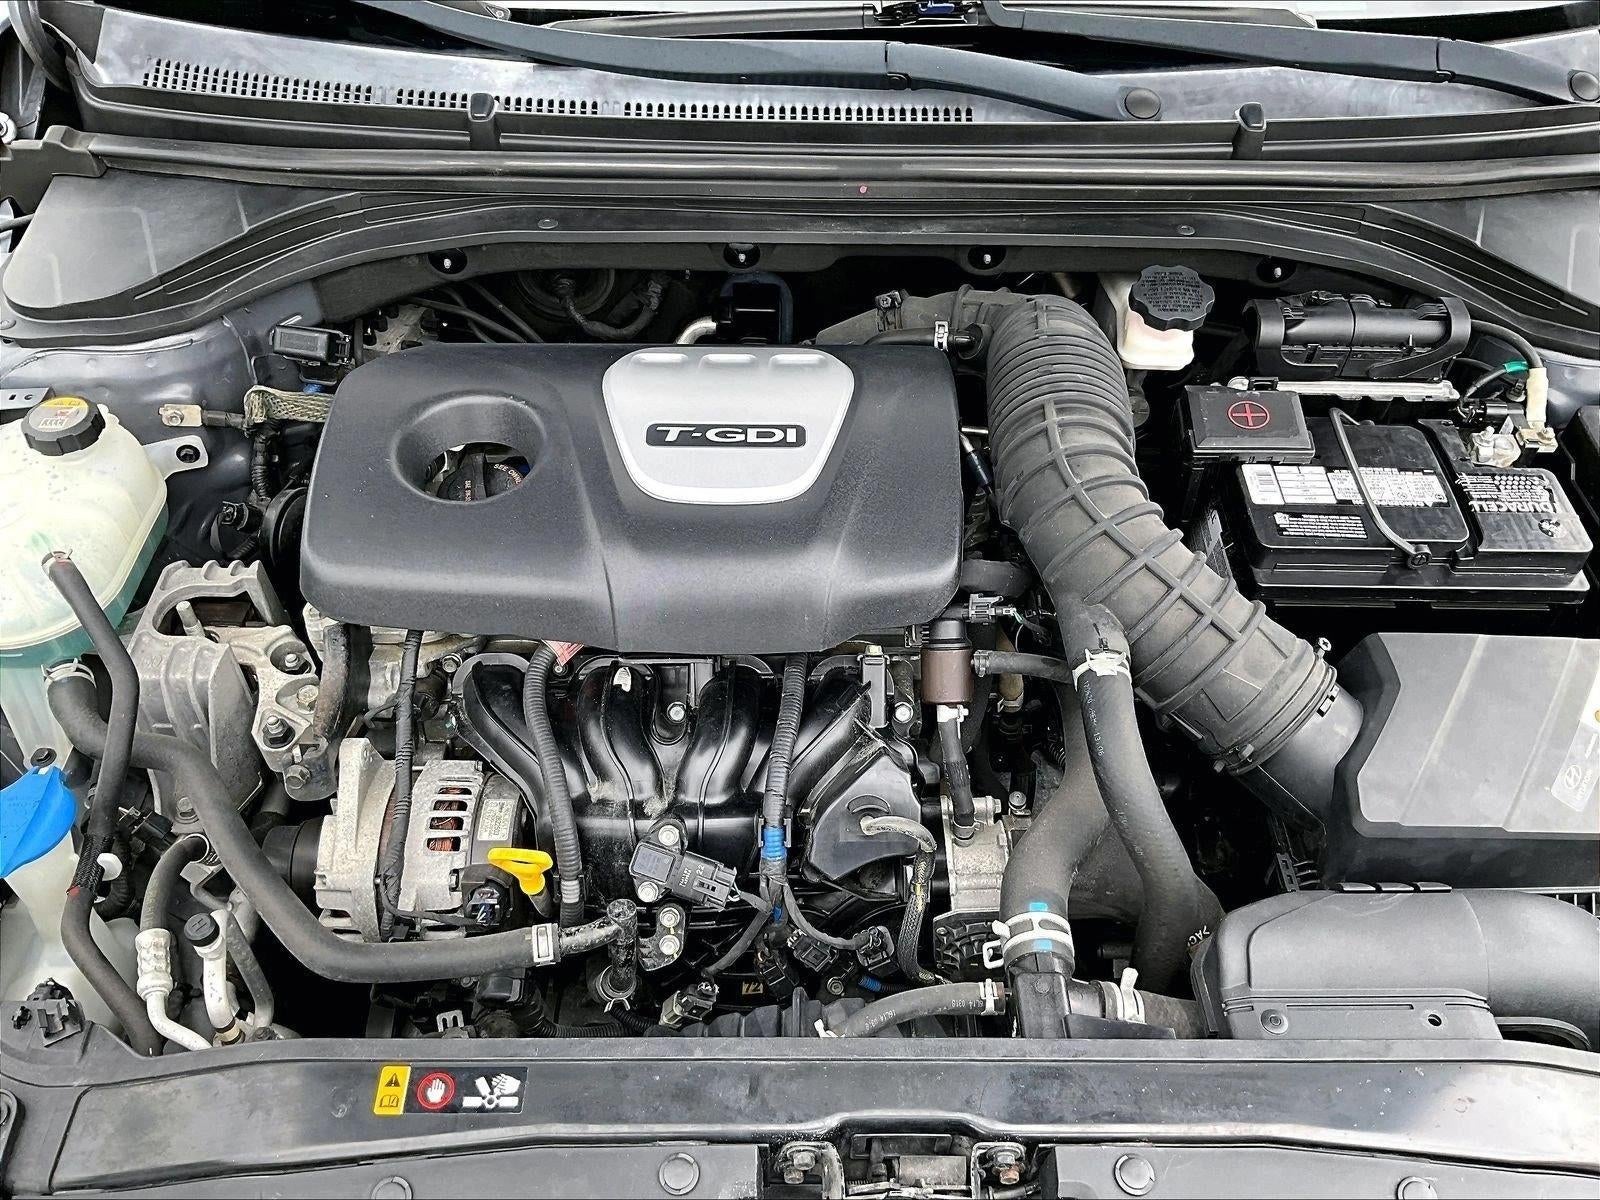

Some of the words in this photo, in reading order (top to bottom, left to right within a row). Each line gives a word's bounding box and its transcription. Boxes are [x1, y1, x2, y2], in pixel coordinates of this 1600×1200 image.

[656, 426, 797, 444] T-GDI
[493, 463, 509, 472] SEE
[508, 469, 522, 485] OWNE
[1468, 500, 1555, 514] DURACELL
[1188, 925, 1210, 946] 7AC
